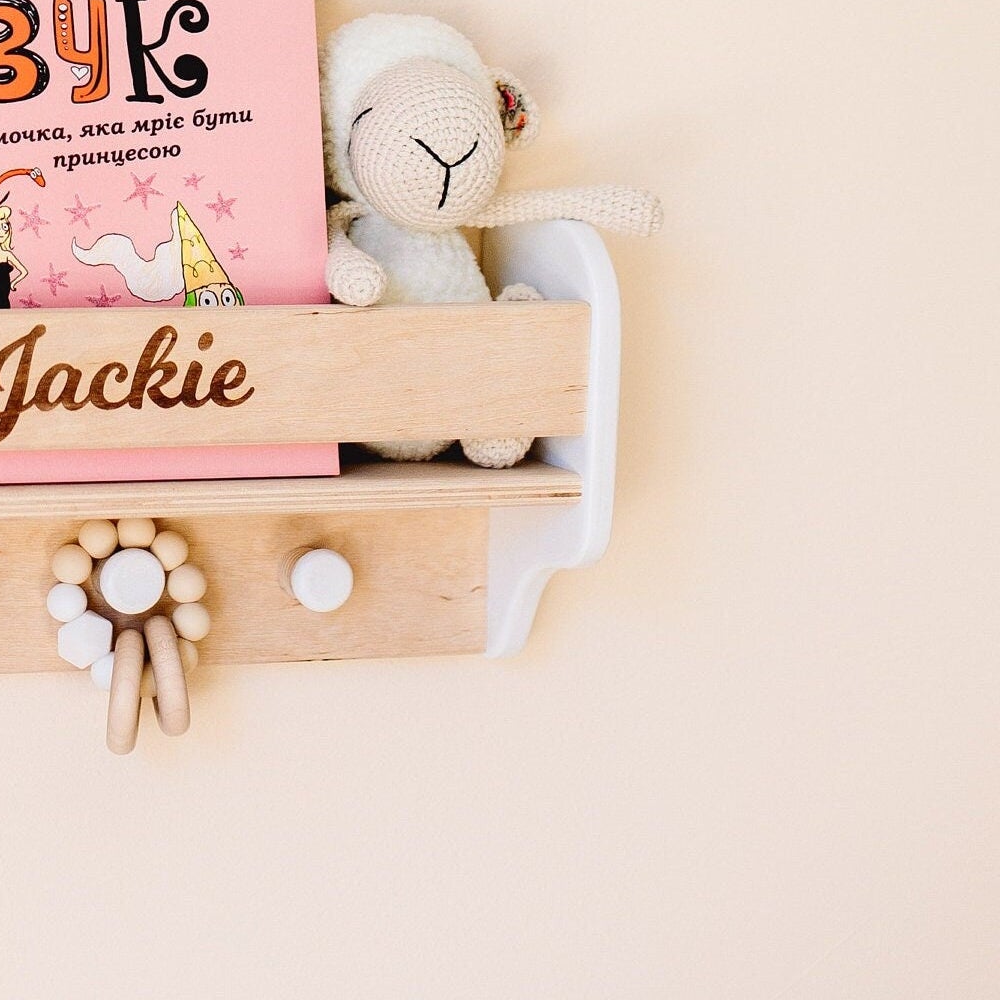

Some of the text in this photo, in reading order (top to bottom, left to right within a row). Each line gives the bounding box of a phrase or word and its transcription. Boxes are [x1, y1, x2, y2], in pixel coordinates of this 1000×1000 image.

[79, 120, 125, 139] яка
[131, 114, 185, 138] мріє
[192, 107, 254, 131] бути
[53, 144, 182, 171] принцесою
